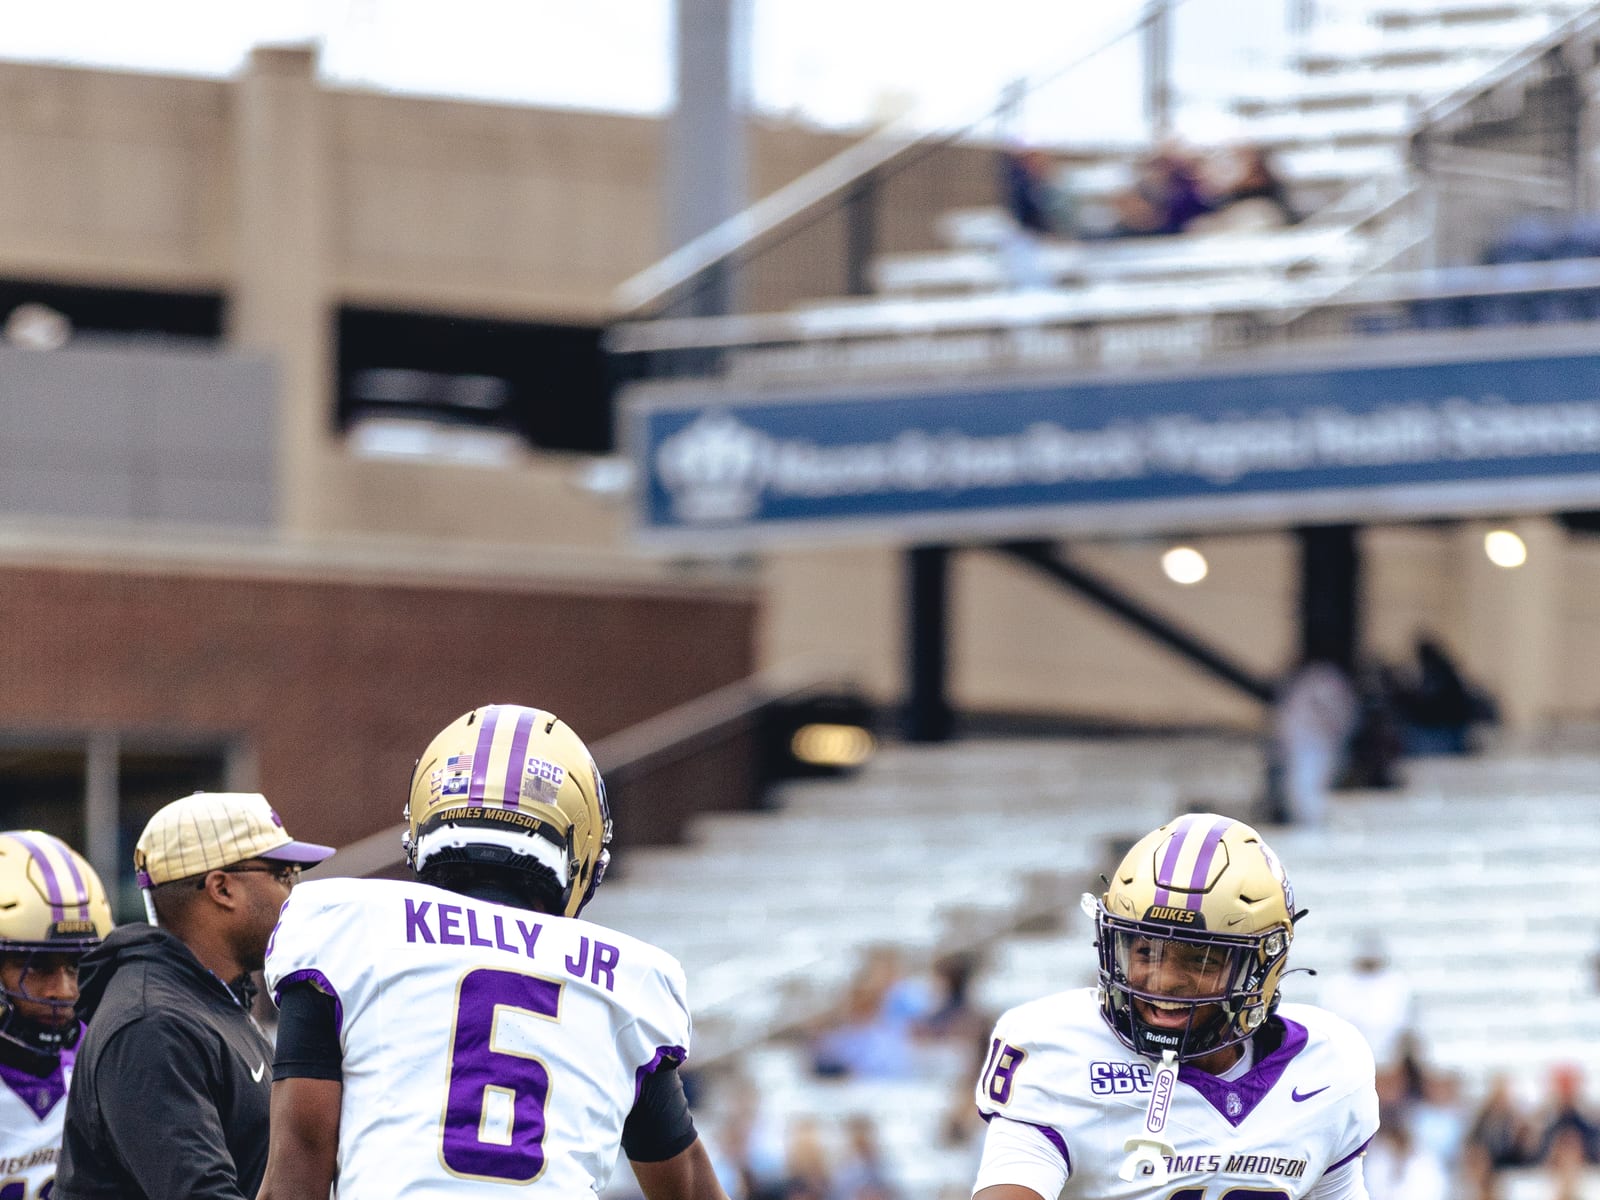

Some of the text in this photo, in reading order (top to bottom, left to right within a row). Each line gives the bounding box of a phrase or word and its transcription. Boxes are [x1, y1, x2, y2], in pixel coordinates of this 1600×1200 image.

[441, 807, 542, 831] JAMES MADISON
[1150, 907, 1195, 923] DUKES
[404, 898, 620, 992] KELLY JR
[1145, 1031, 1179, 1046] Riddell
[437, 964, 567, 1186] 6
[1090, 1062, 1154, 1095] SBC
[1150, 1073, 1171, 1128] BATTLE
[1225, 1155, 1307, 1178] MADISON
